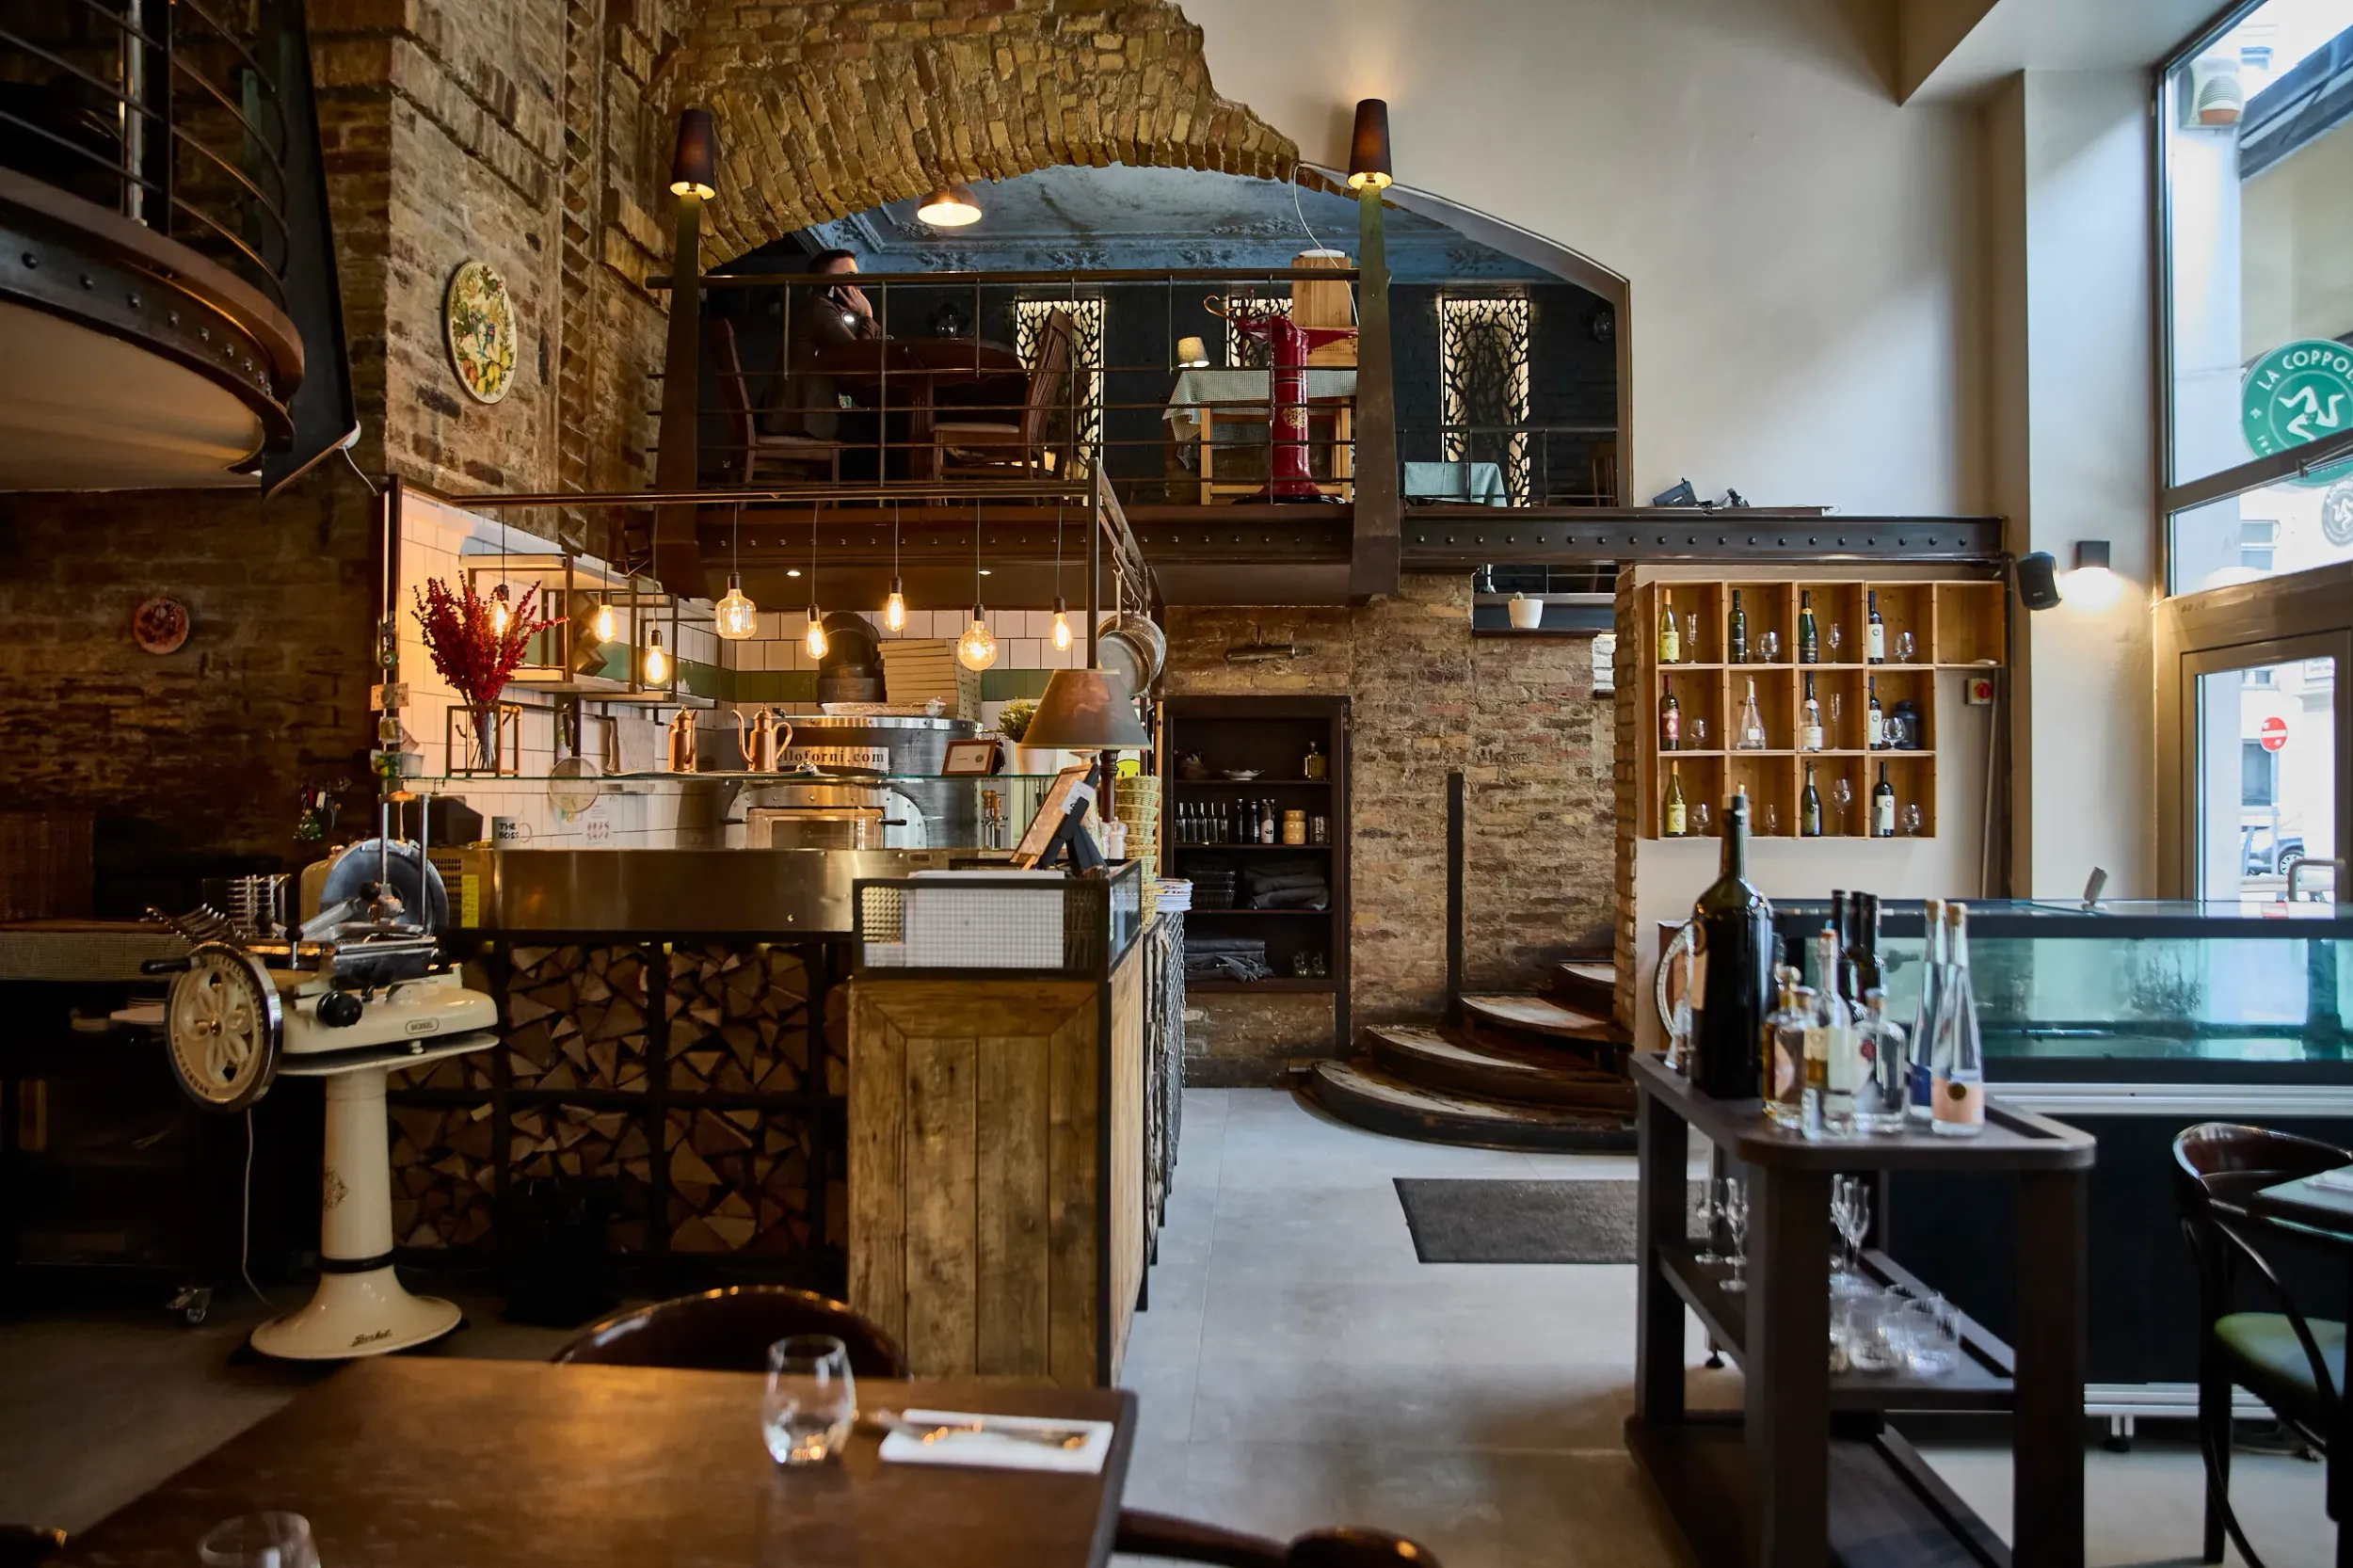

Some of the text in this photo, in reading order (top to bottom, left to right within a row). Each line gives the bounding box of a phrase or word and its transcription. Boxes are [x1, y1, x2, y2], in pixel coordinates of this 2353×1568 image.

[2257, 349, 2353, 391] LA COPPOL
[778, 750, 884, 762] elloforni.com
